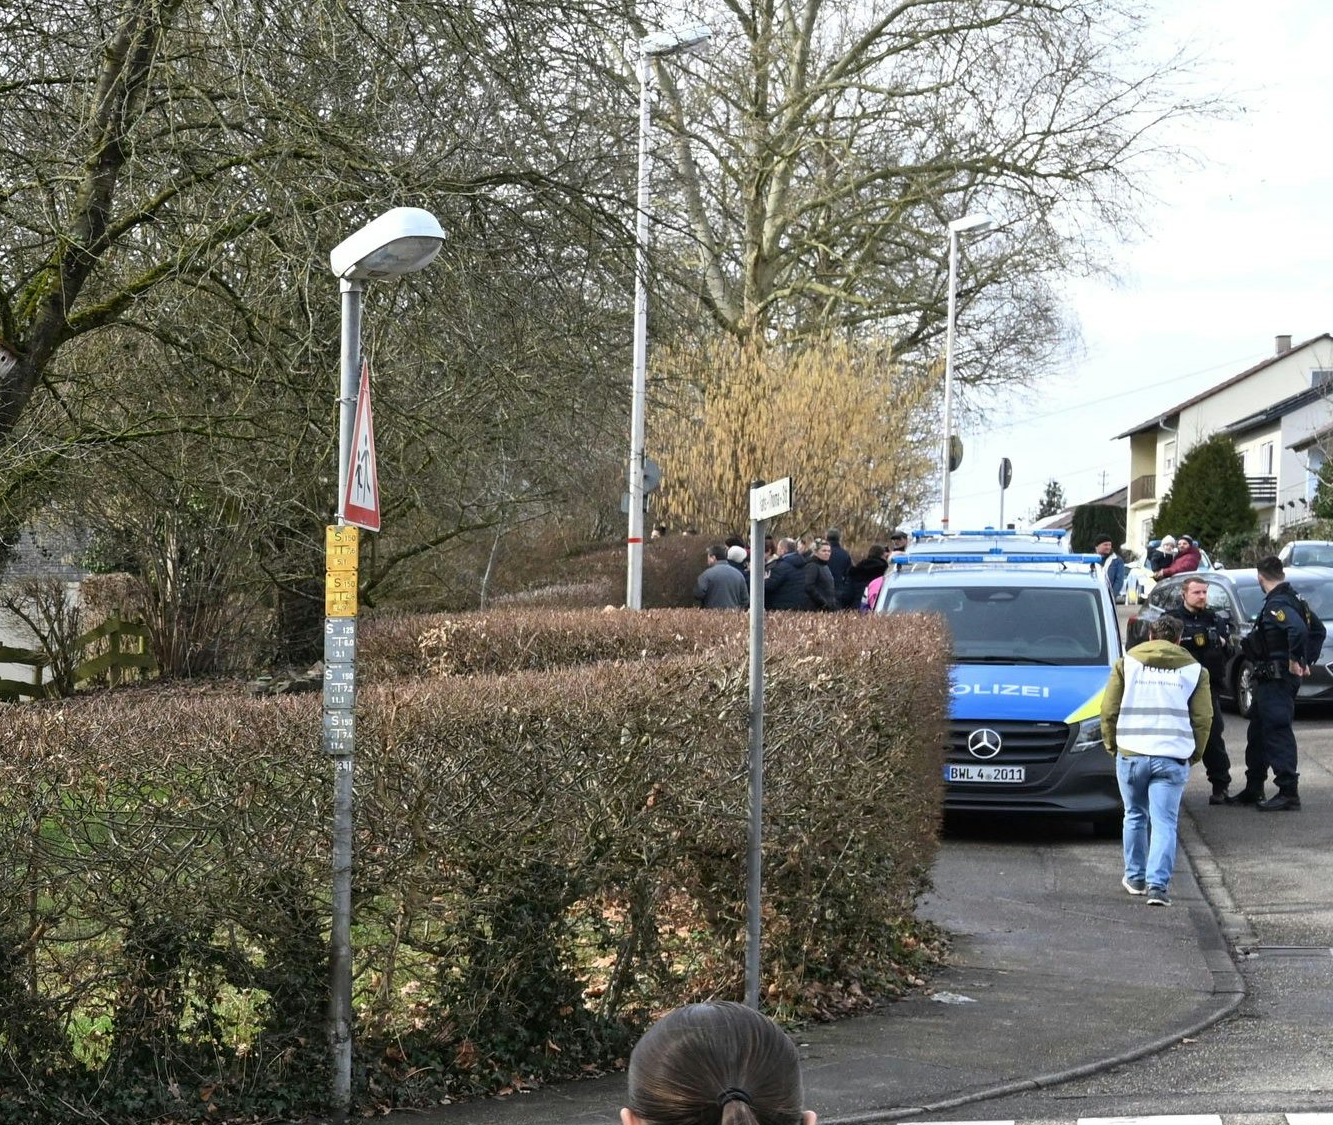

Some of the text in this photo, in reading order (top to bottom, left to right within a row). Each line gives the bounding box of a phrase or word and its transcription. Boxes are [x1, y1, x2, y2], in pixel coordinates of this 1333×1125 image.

[334, 531, 342, 542] S
[334, 577, 341, 588] S
[326, 623, 354, 634] S 125
[325, 669, 353, 680] S 150
[949, 683, 1049, 698] OLIZEI
[331, 715, 353, 726] S 150
[950, 767, 1024, 781] BWL 4 2011
